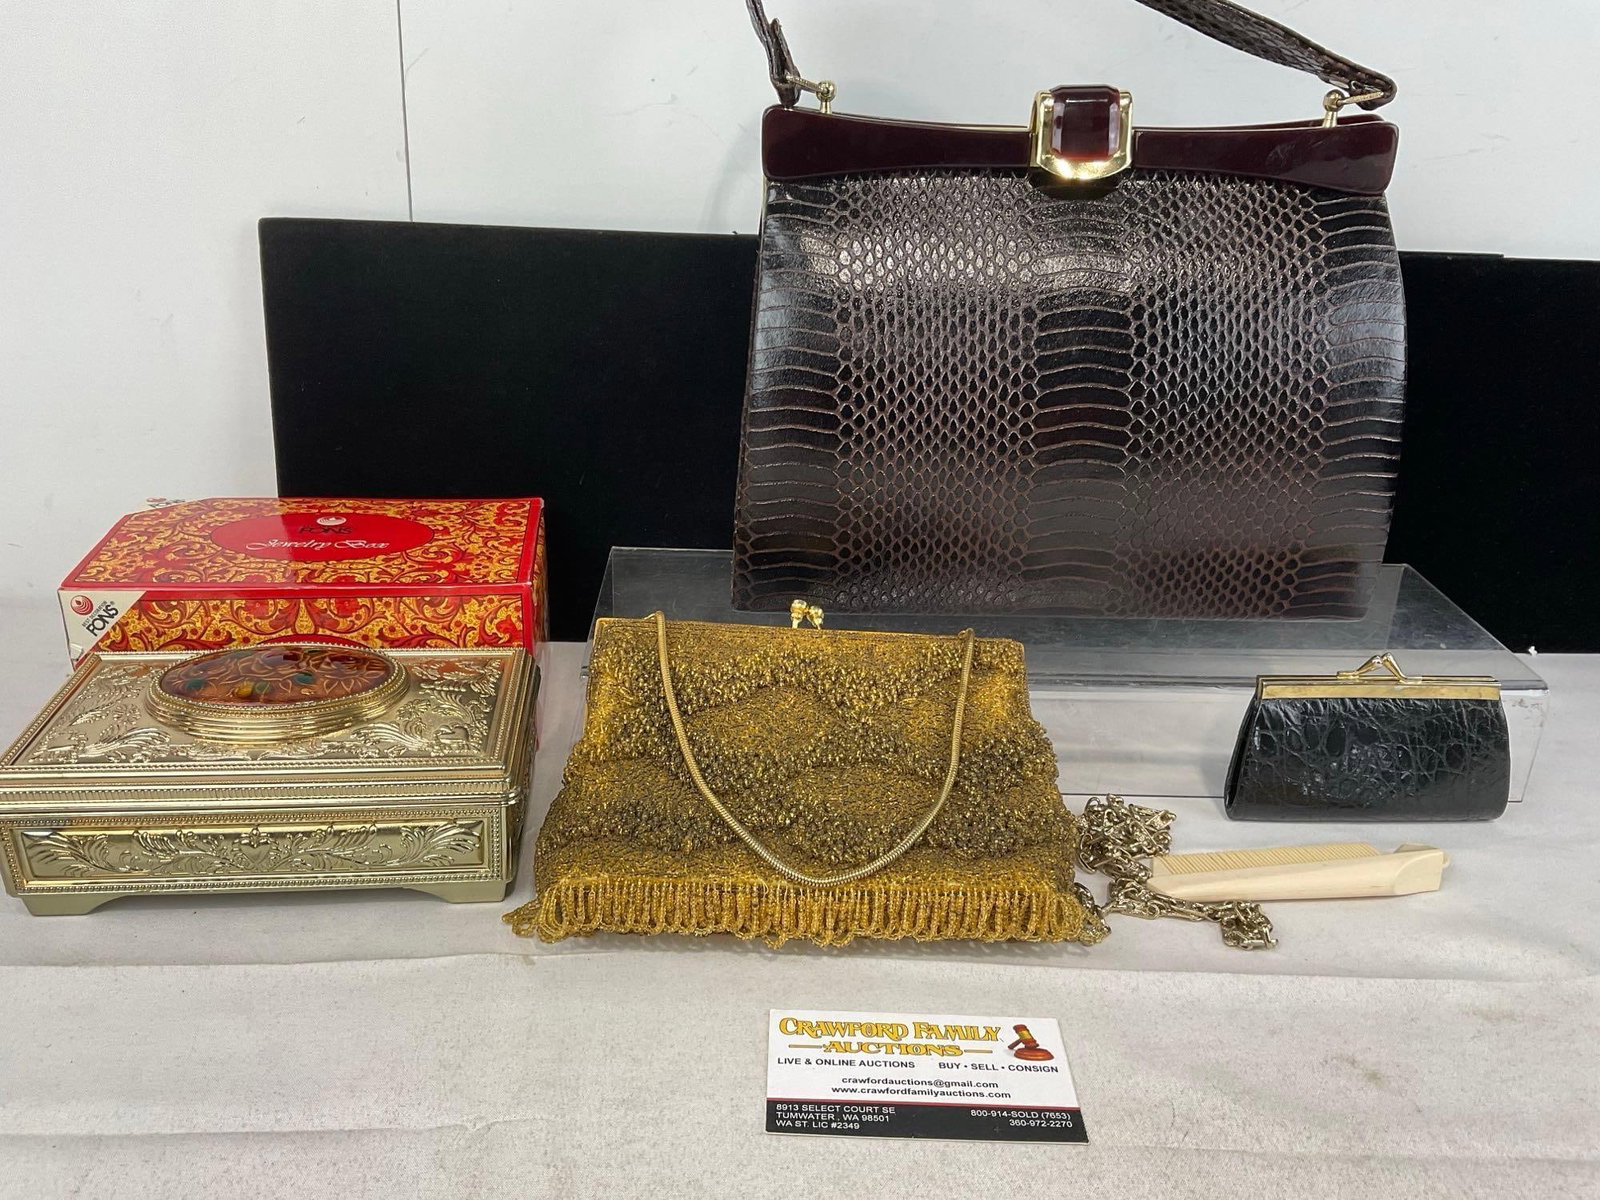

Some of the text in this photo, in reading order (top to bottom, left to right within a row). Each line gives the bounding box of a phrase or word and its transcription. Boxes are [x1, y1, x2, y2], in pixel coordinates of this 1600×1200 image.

[246, 539, 390, 551] Jewelry Box
[779, 1017, 1002, 1042] CRAWFORD FAMILY
[822, 1041, 964, 1057] AUCTIONS
[777, 1057, 916, 1069] LIVE & ONLINE AUCTIONS
[938, 1062, 1059, 1073] BUY SELL CONSIGN
[841, 1076, 999, 1089] crawfordauctions@gmail.com
[831, 1086, 1011, 1099] www.crawfordfamilyauctions.com
[776, 1103, 896, 1114] 8913 SELECT COURT SE
[842, 1113, 860, 1121] WA
[861, 1114, 890, 1122] 98501
[970, 1109, 1071, 1120] 800-914-SOLD (7653)
[775, 1119, 793, 1127] WA
[794, 1120, 810, 1128] ST.
[830, 1121, 860, 1129] #2349
[1009, 1118, 1073, 1128] 360-972-2270
